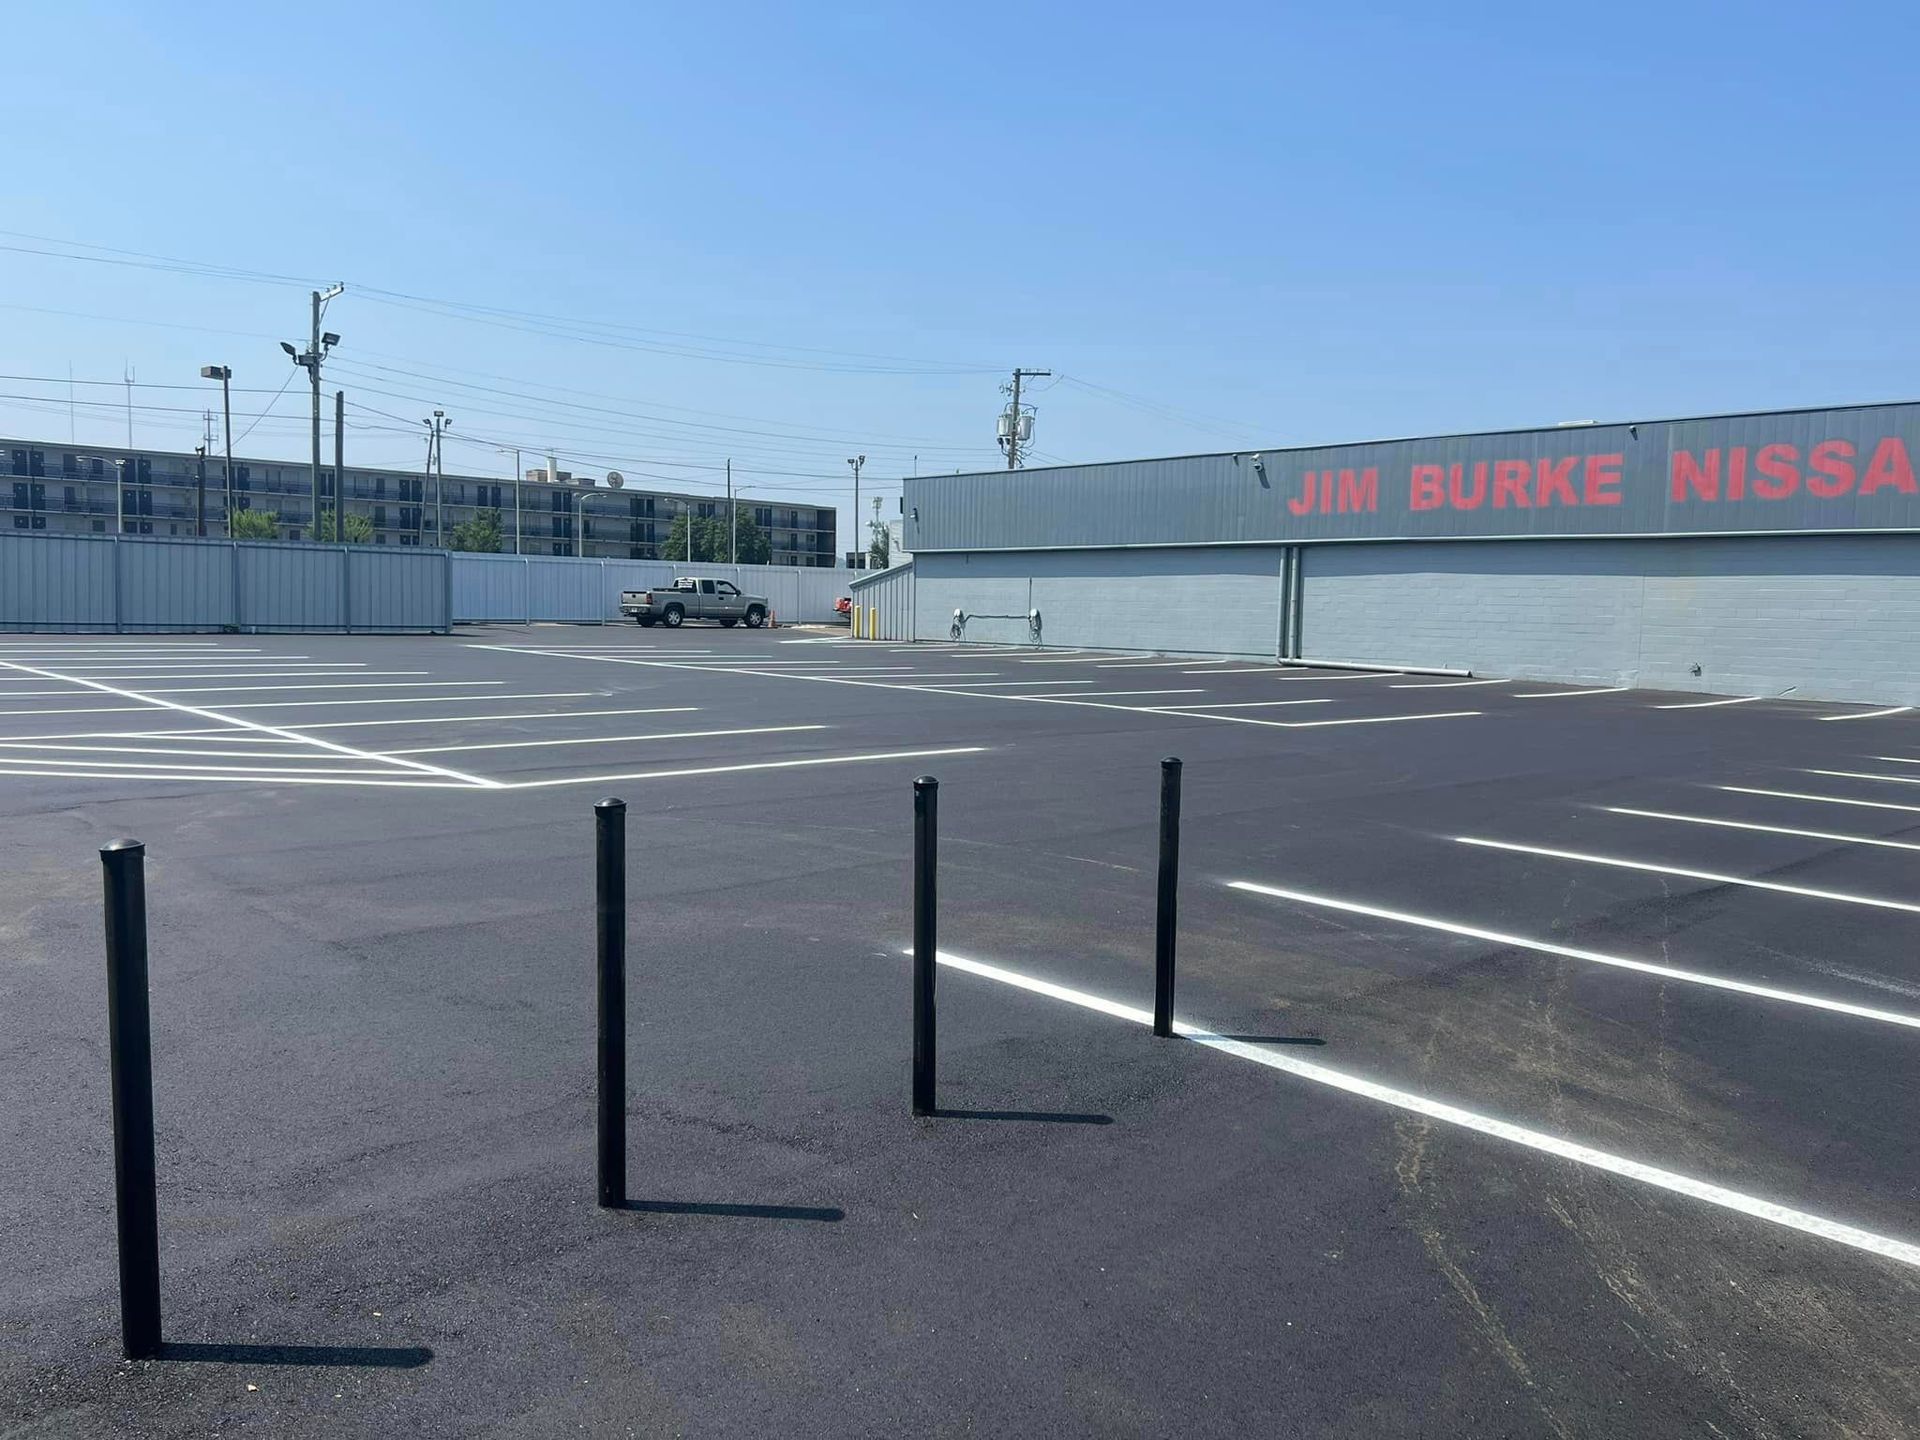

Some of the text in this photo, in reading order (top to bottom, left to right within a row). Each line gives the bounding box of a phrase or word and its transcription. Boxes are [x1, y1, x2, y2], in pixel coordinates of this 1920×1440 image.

[1288, 437, 1919, 515] JIM BURKE NISSA
